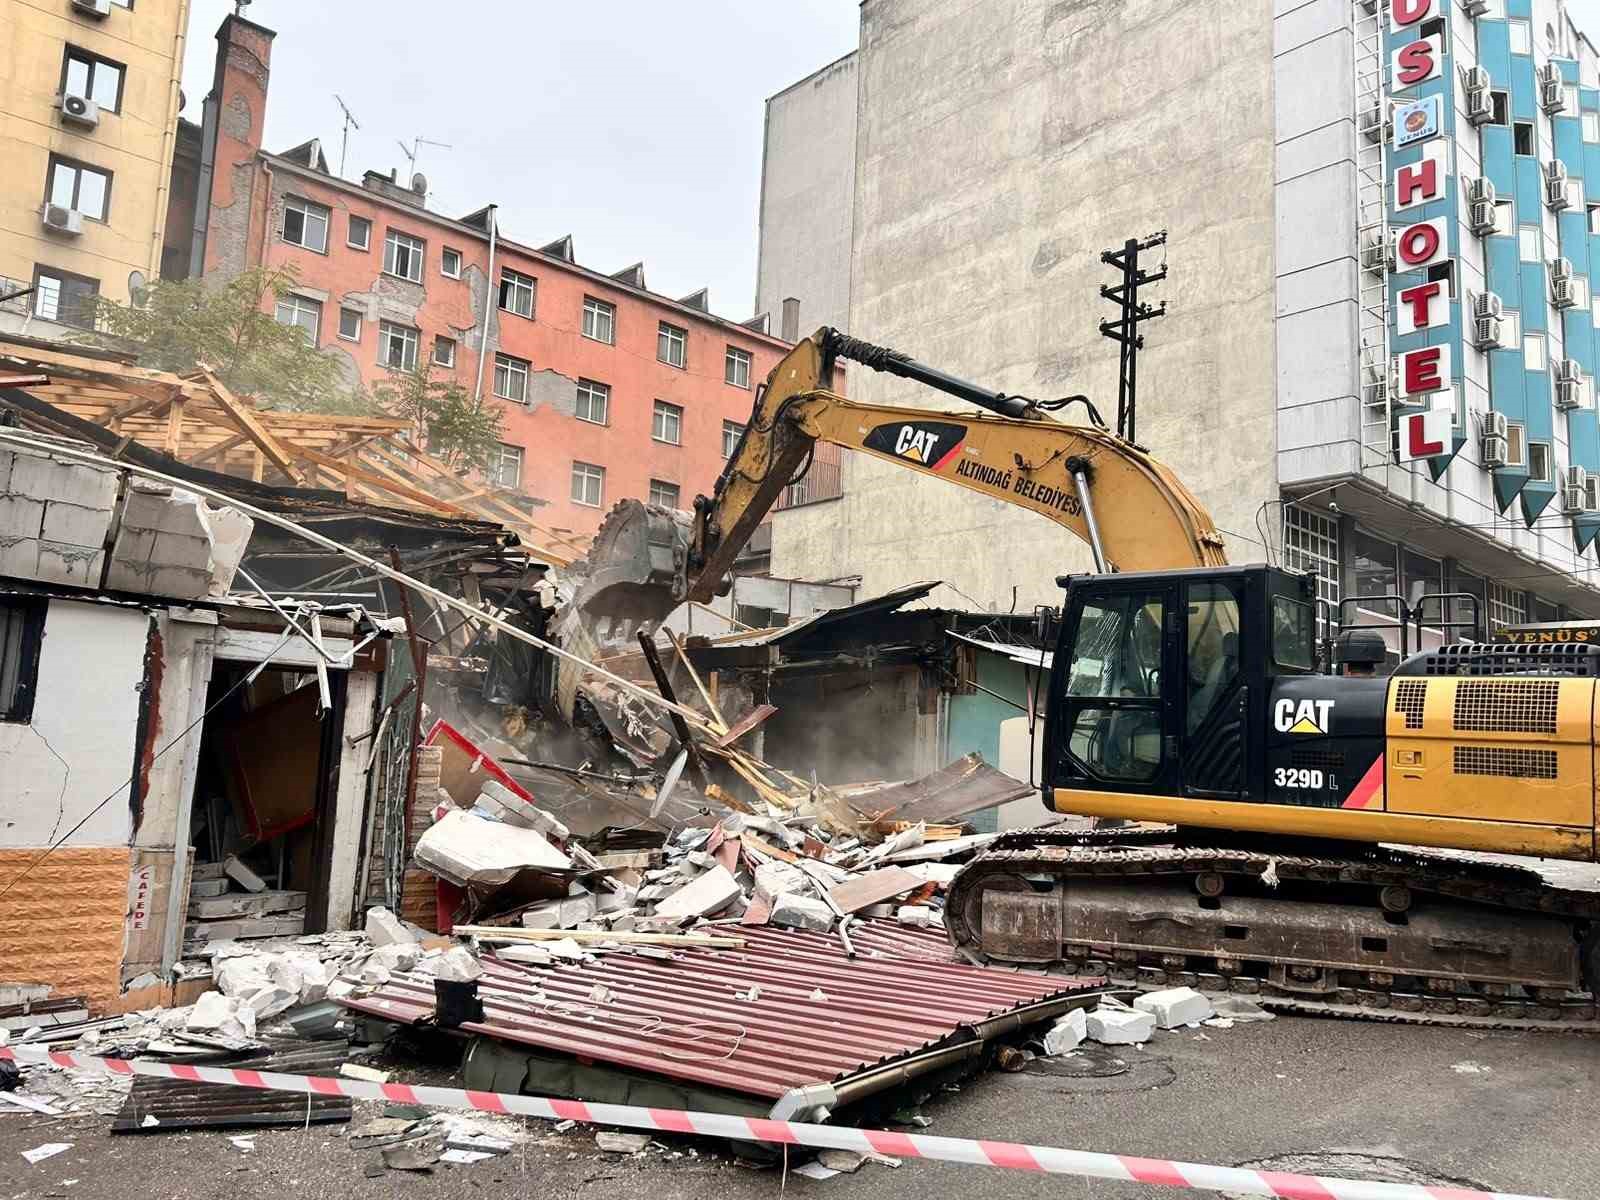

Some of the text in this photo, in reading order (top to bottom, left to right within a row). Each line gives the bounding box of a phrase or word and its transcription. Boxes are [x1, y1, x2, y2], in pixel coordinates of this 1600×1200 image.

[1399, 159, 1443, 458] HOTEL
[895, 425, 939, 463] CAT
[956, 459, 1013, 490] ALTINDAĞ
[1274, 699, 1335, 734] CAT
[1274, 767, 1339, 790] 329D L
